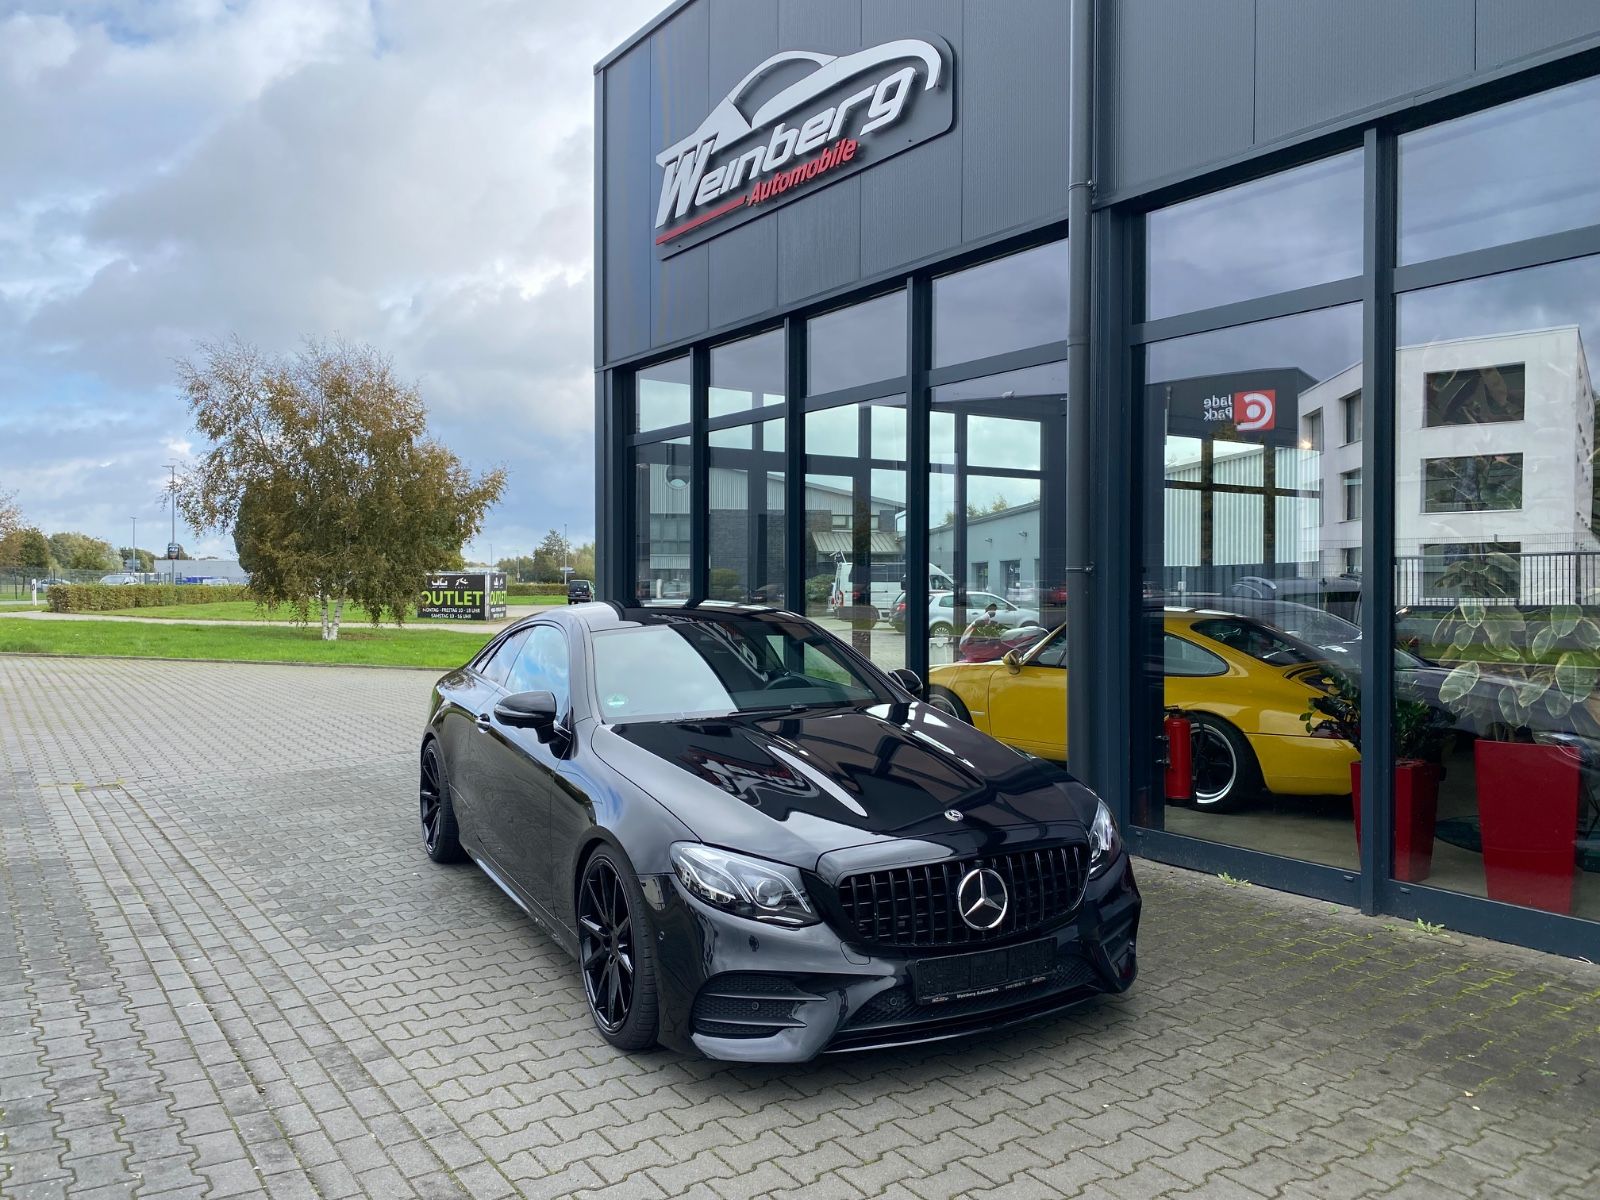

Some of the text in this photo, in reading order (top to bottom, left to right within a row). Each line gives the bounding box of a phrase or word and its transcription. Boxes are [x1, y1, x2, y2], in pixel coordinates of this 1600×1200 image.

[655, 67, 916, 229] Weinberg
[747, 137, 858, 207] Automobile
[421, 590, 484, 606] OUTLET
